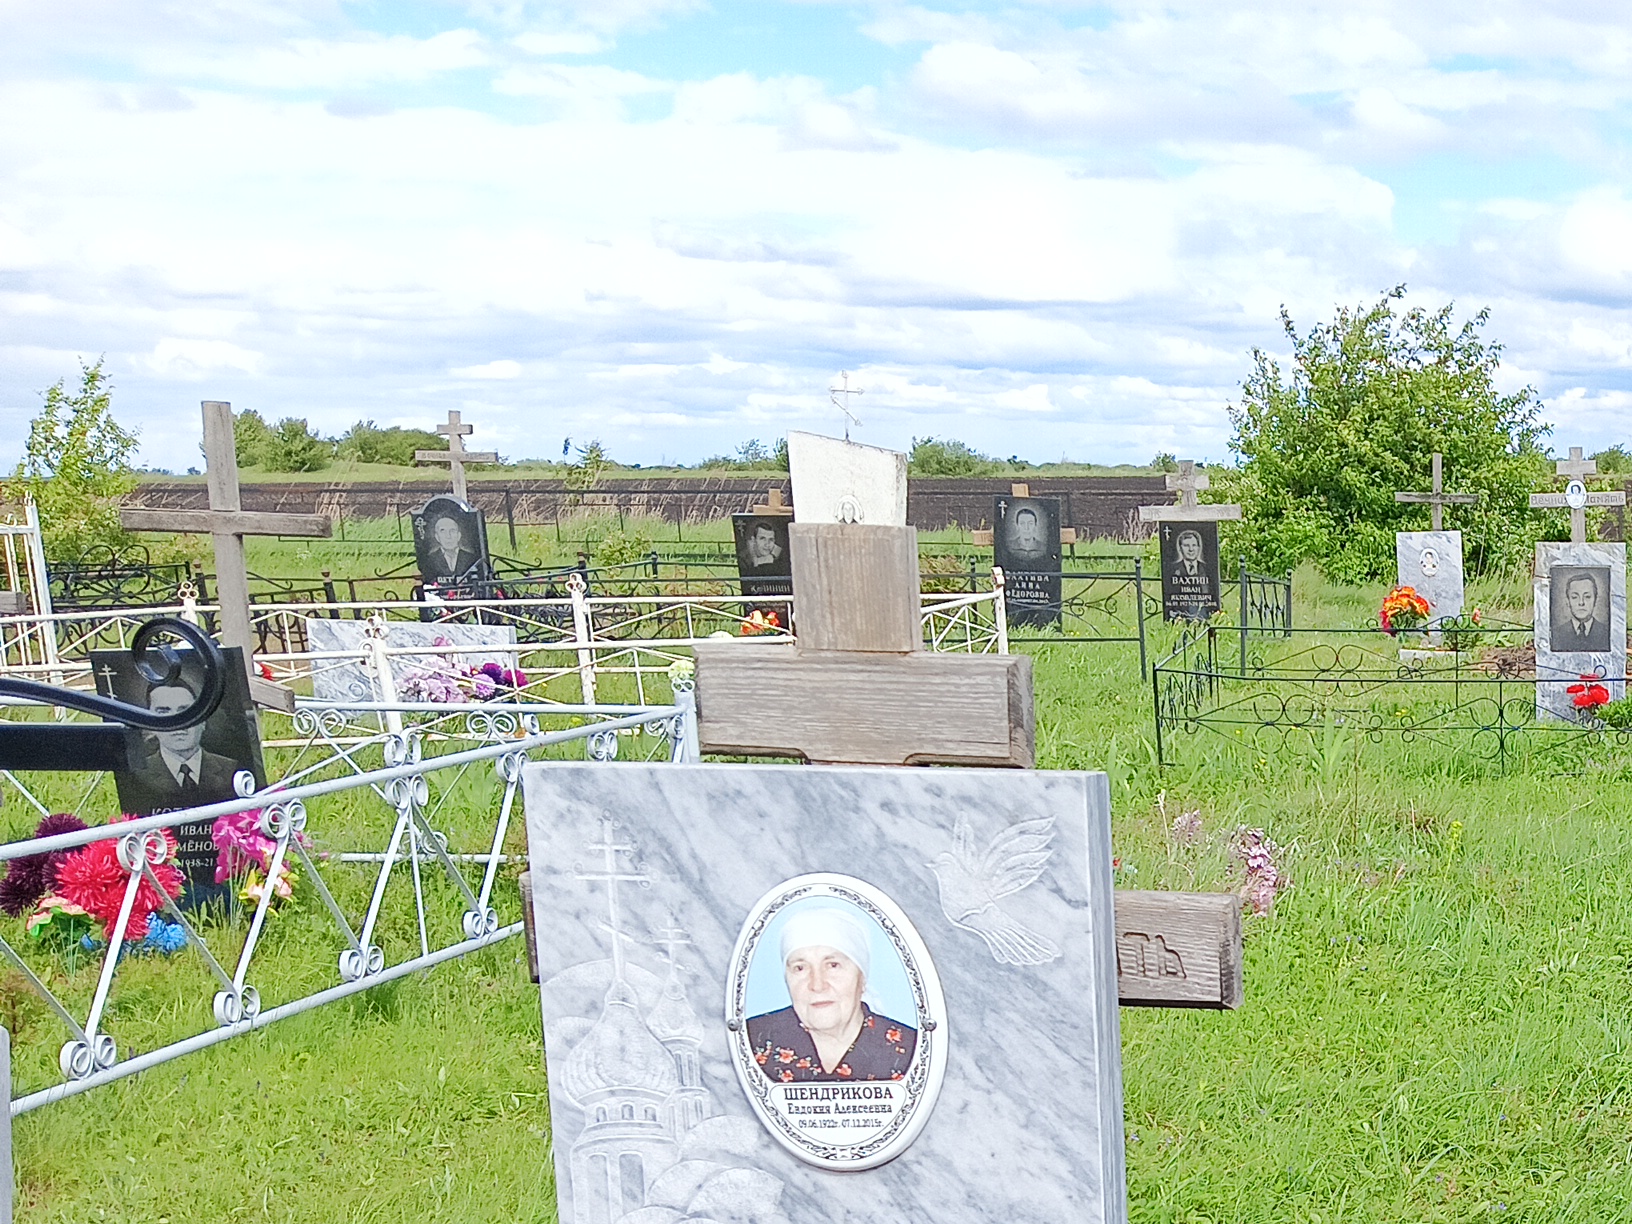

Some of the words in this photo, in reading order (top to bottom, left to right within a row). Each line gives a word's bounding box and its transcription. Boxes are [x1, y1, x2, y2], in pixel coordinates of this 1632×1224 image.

[1584, 493, 1624, 504] амять
[1014, 582, 1041, 590] АННА
[1171, 576, 1209, 585] ВАХТИН
[1181, 586, 1201, 594] ИВАН
[179, 824, 213, 836] ИВАН
[784, 1086, 894, 1102] ШЕНДРИКОВА
[787, 1103, 832, 1116] Евдокия
[833, 1102, 893, 1115] Алексеевна
